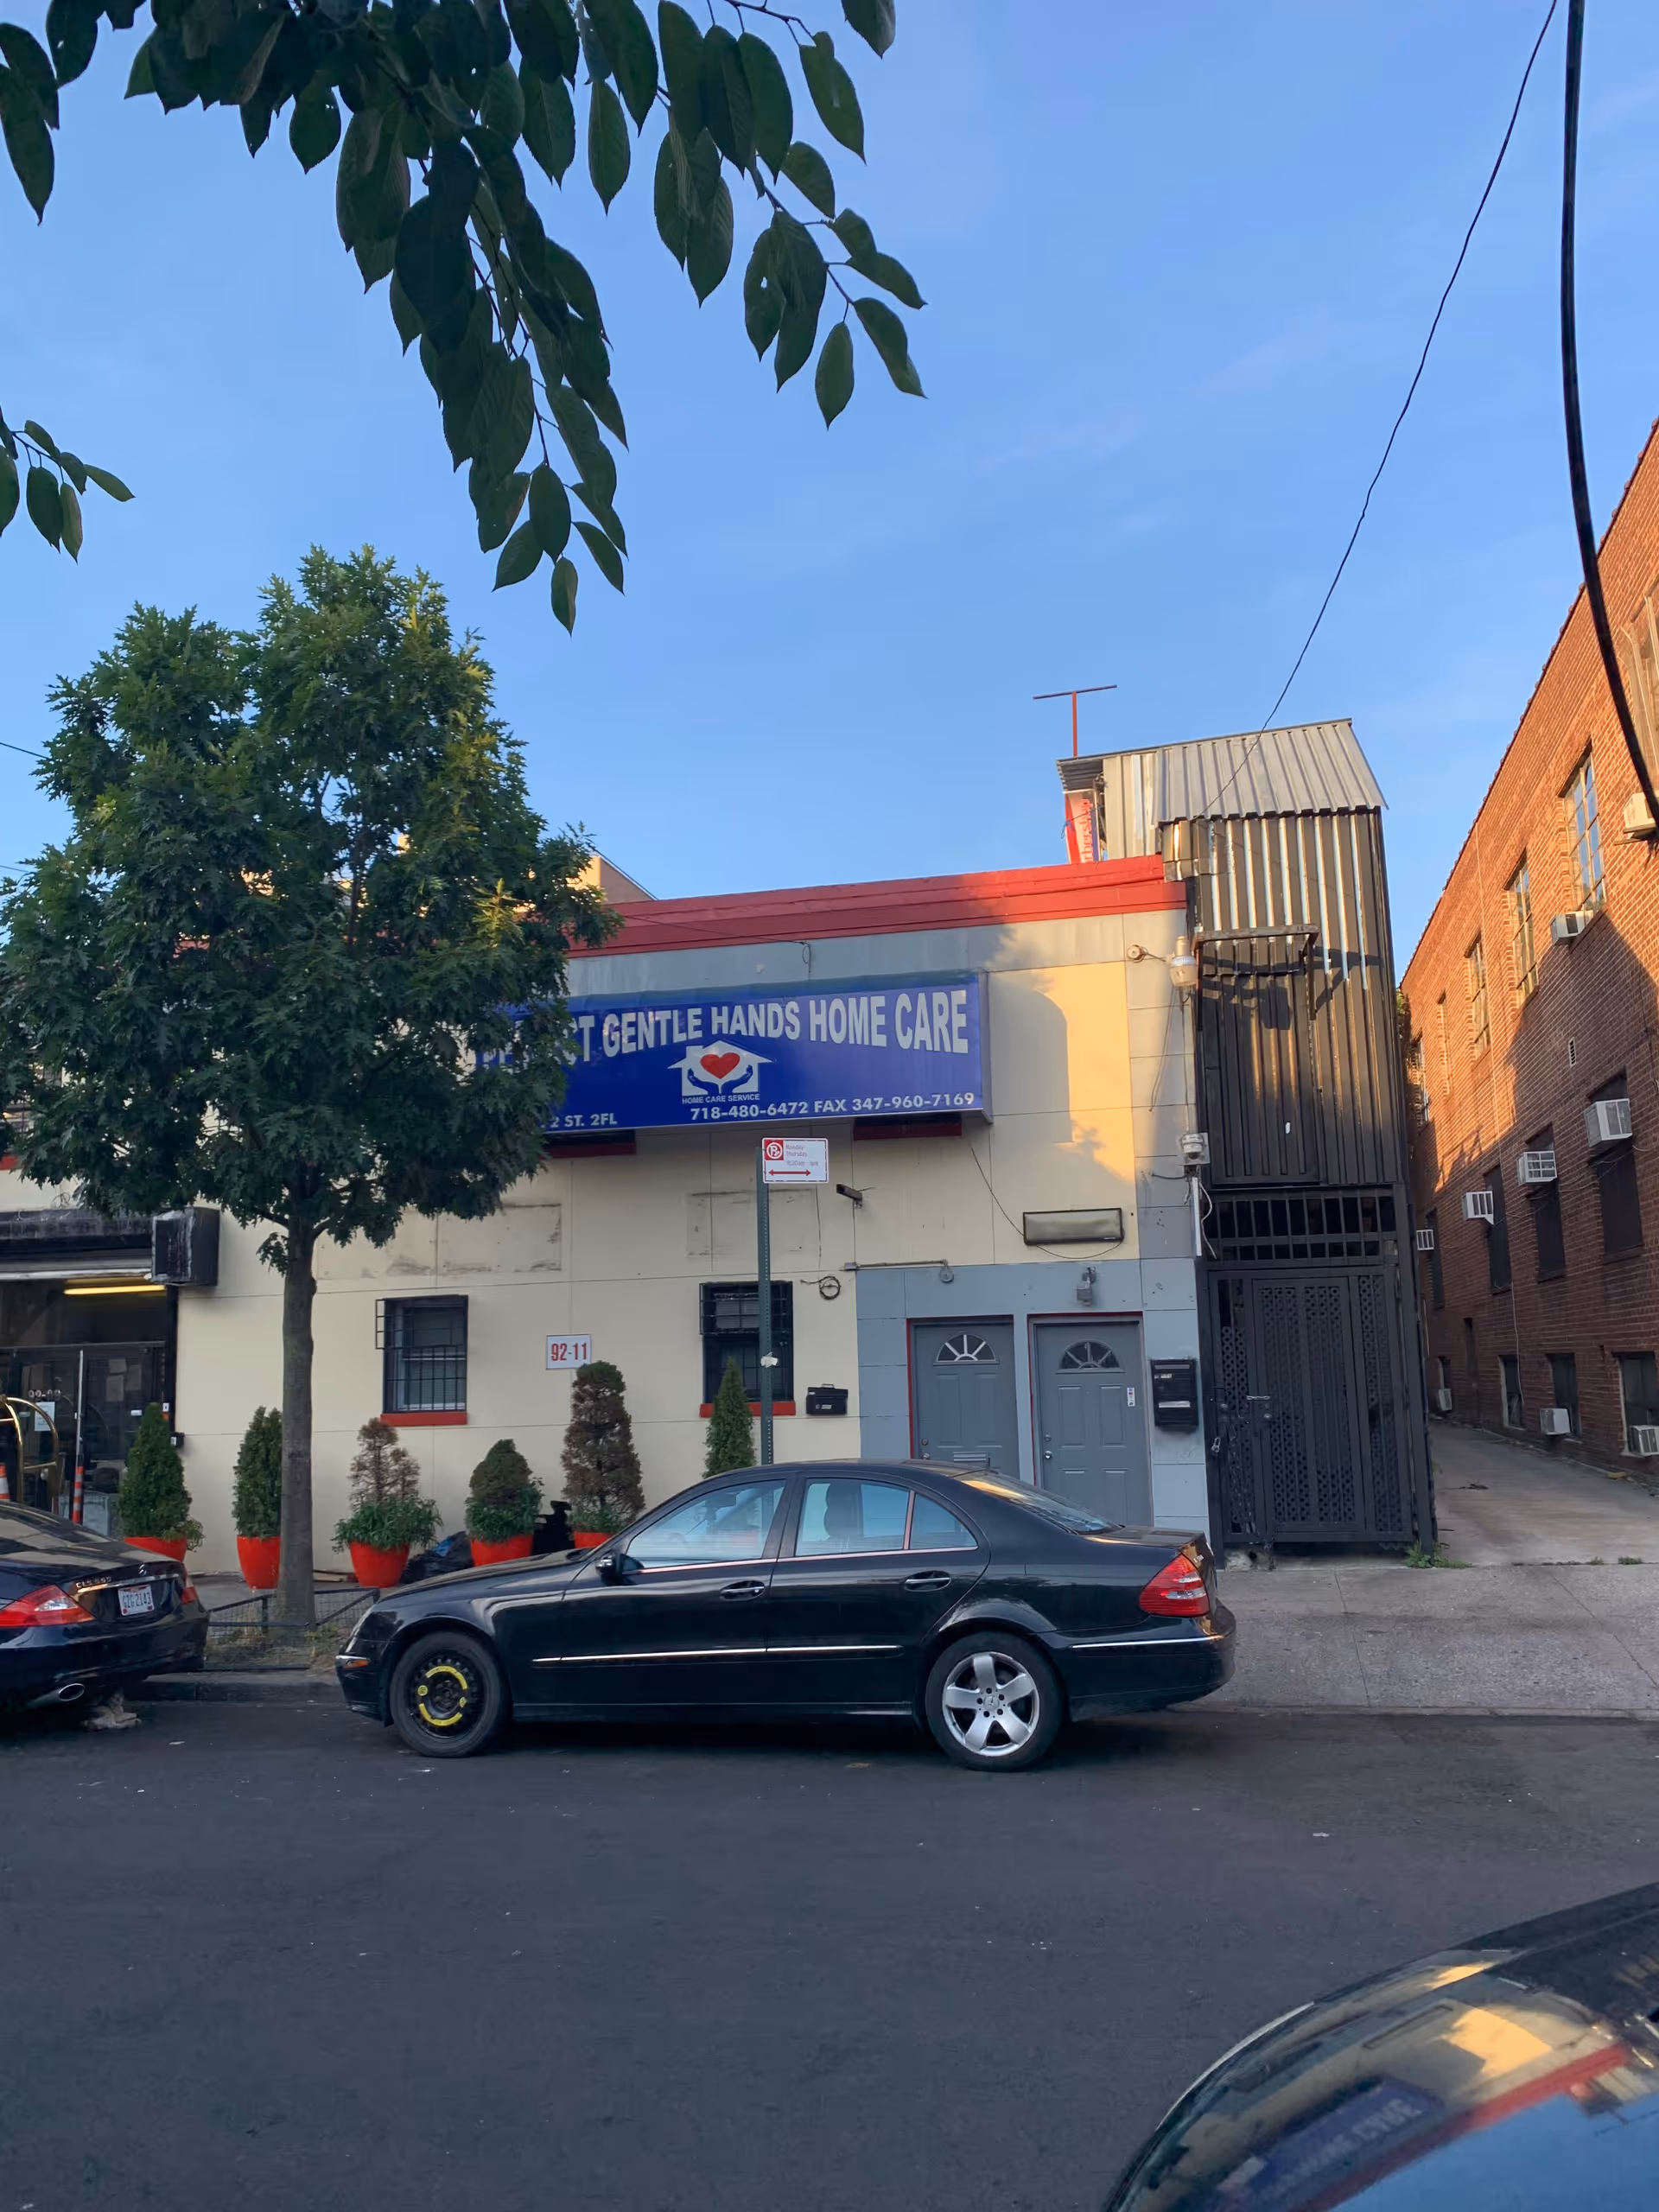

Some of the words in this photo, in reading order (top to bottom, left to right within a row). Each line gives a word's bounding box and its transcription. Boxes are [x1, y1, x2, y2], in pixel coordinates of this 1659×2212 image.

[602, 1007, 703, 1058] GENTLE
[710, 1001, 801, 1040] HANDS
[809, 995, 887, 1048] HOME
[894, 989, 969, 1054] CARE
[728, 1093, 760, 1102] SERVICE
[690, 1101, 809, 1121] 718-480-6472
[814, 1099, 848, 1113] FAX
[852, 1092, 975, 1111] 347-960-7169
[564, 1115, 585, 1127] ST.
[590, 1113, 618, 1126] 2FL
[551, 1342, 587, 1362] 92-11
[135, 1592, 151, 1606] 2143
